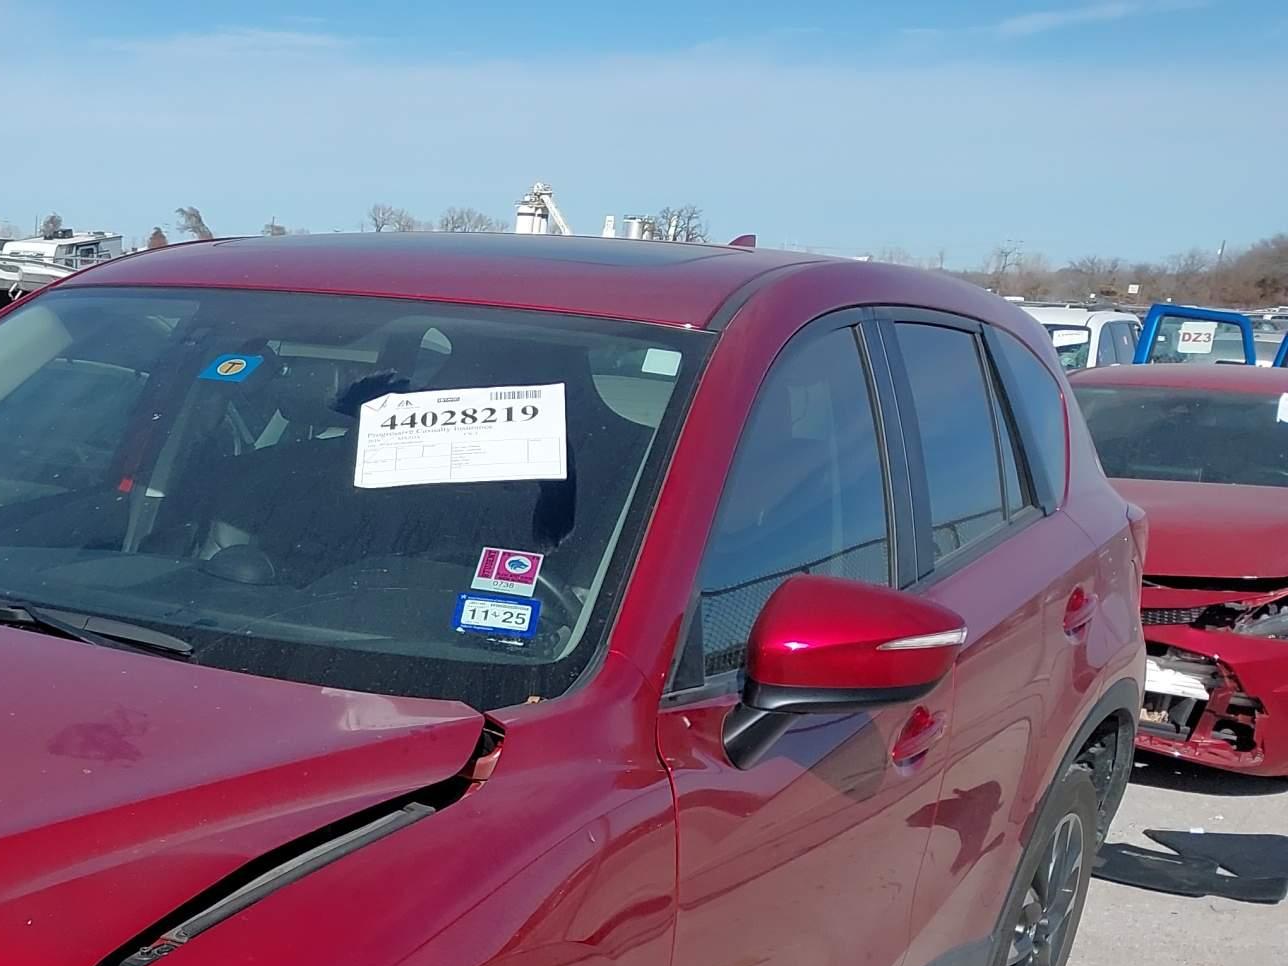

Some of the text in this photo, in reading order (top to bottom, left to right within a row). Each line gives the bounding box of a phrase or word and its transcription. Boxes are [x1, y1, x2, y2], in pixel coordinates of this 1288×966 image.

[1181, 332, 1212, 343] DZ3
[380, 405, 539, 430] 44028219
[367, 427, 414, 438] Progressive
[453, 424, 493, 433] Insurance
[468, 607, 489, 621] 11
[501, 611, 527, 625] 25
